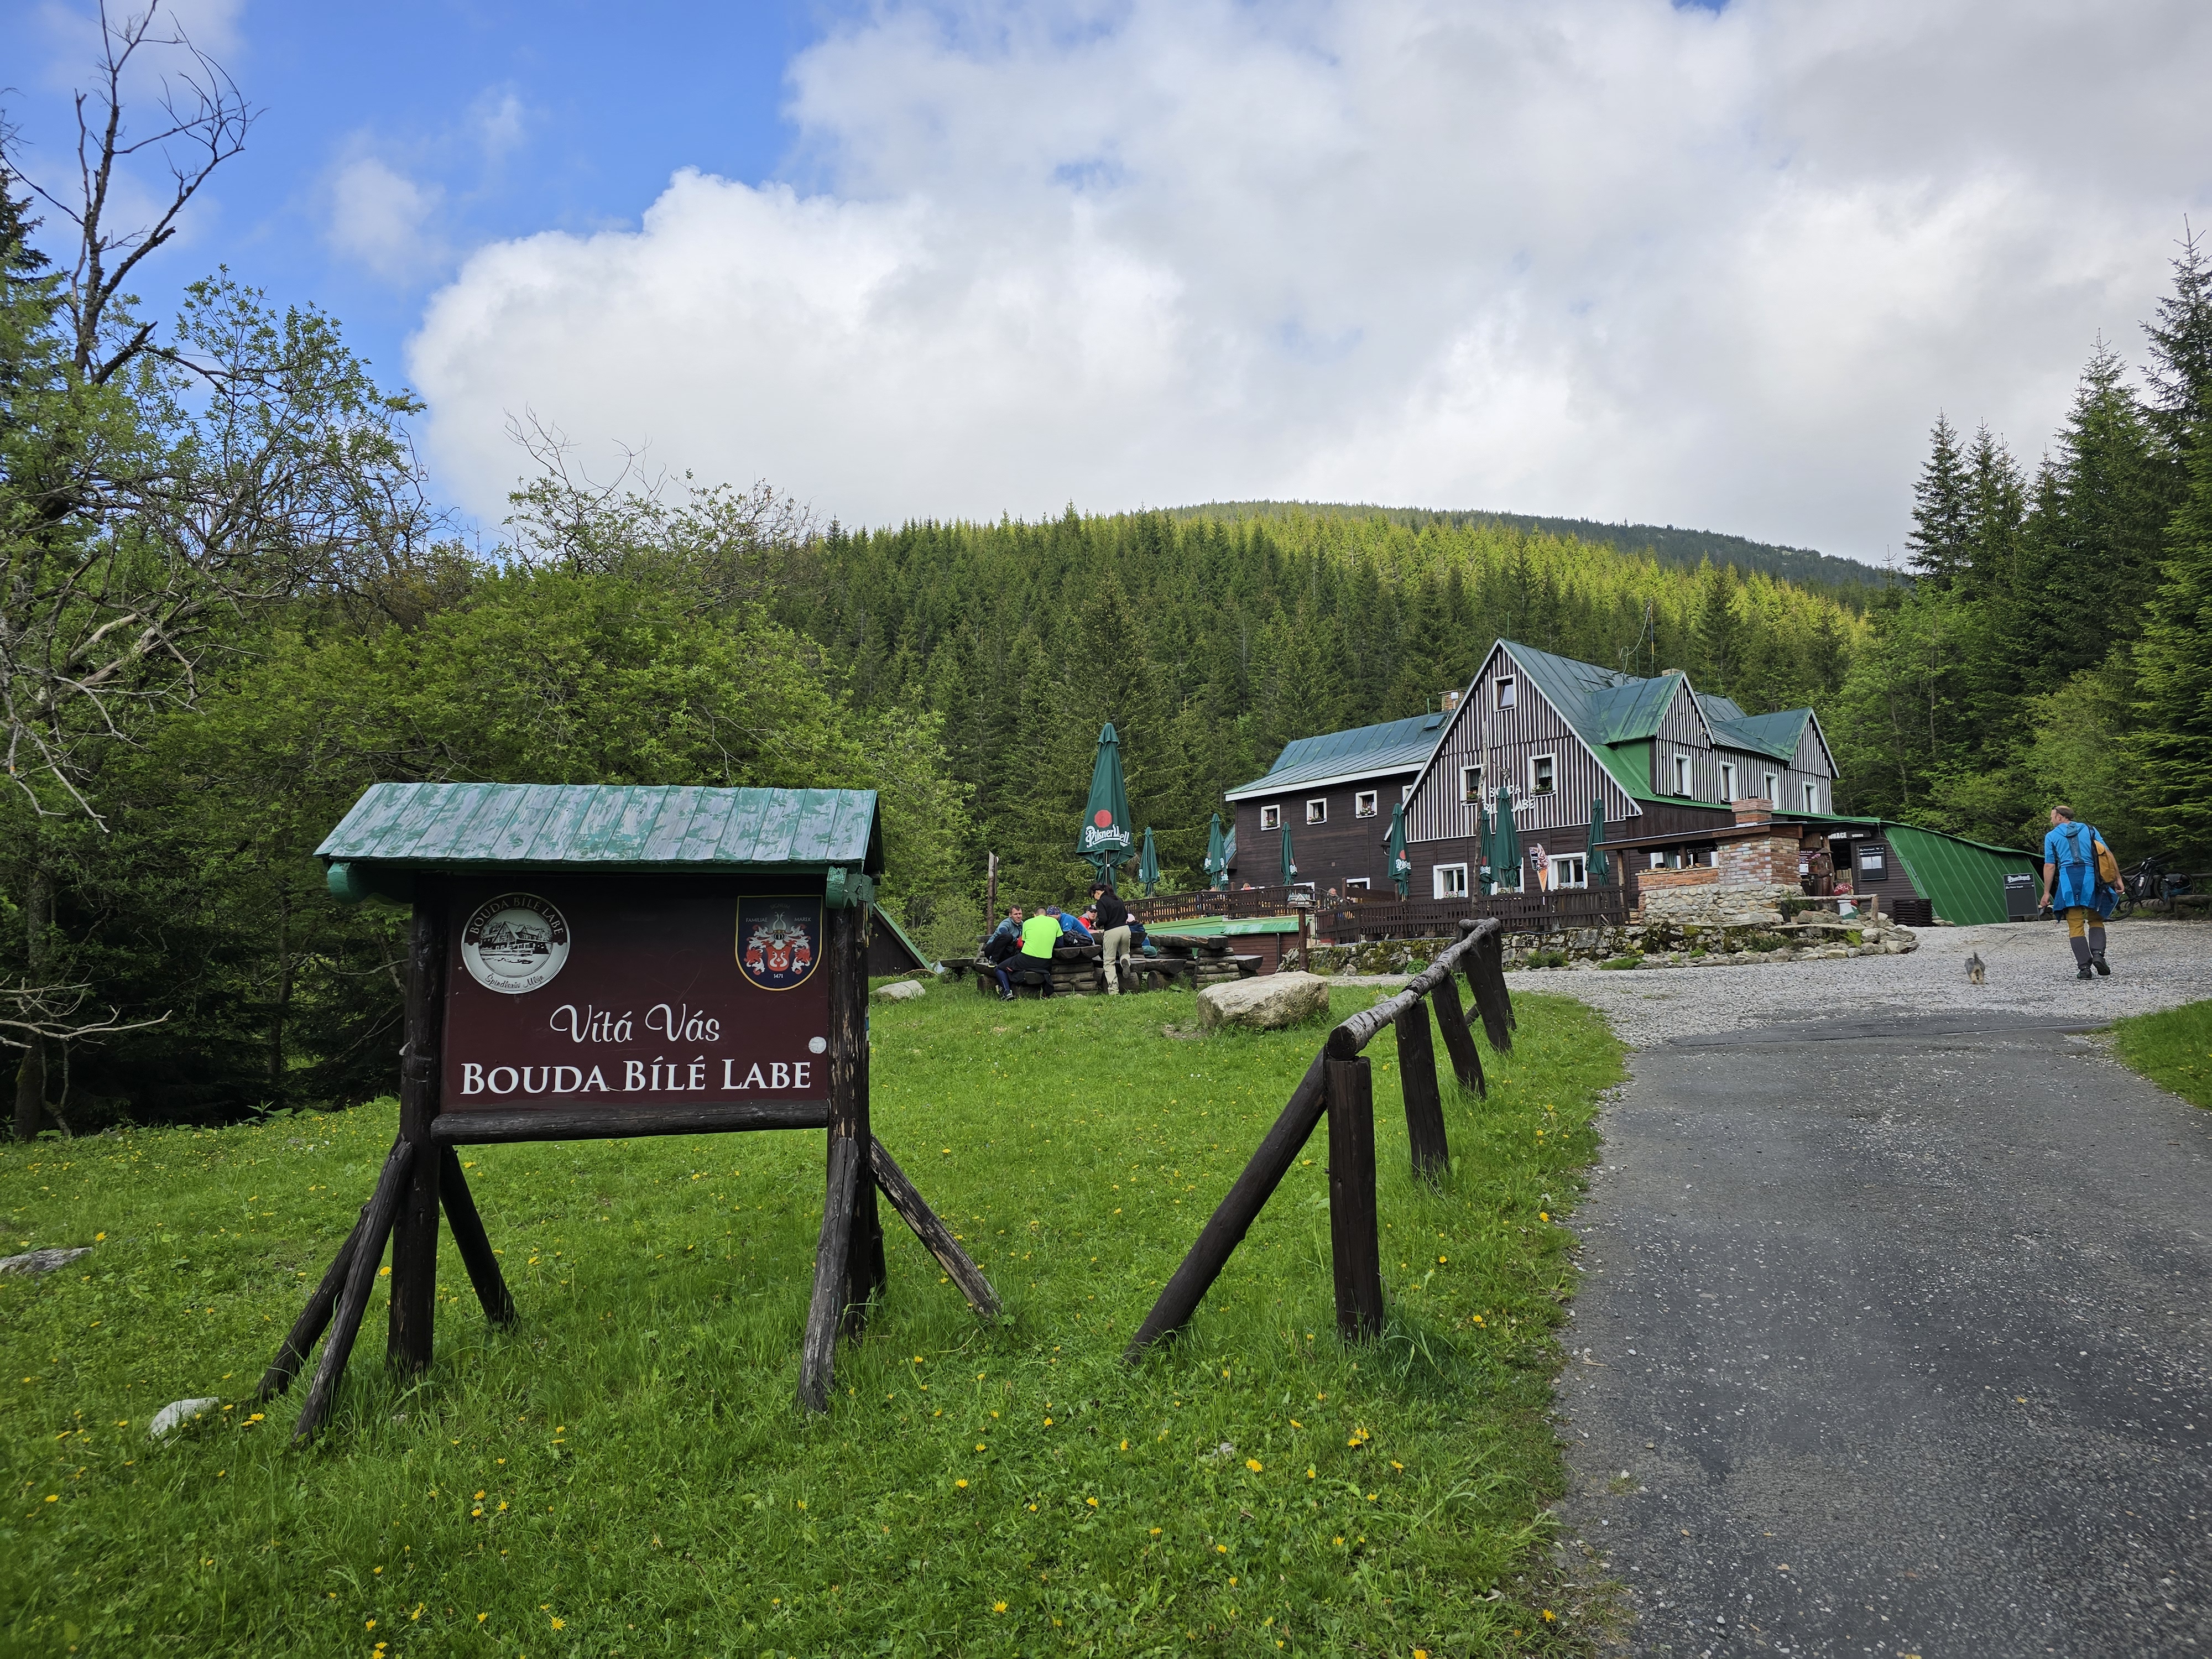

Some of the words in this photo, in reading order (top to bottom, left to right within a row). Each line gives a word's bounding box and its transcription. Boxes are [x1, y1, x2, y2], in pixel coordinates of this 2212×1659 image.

[1511, 798, 1536, 812] ABE
[1086, 825, 1114, 848] Pilsner
[1113, 824, 1129, 845] Uell
[469, 900, 509, 935] BOUDA
[513, 895, 542, 911] BÍLÉ
[542, 907, 564, 935] LABE
[485, 973, 521, 989] Špindlerův
[523, 975, 545, 988] Mlýn
[550, 1004, 633, 1043] Vítá
[645, 1003, 719, 1042] Vás
[460, 1063, 611, 1094] BOUDA
[623, 1055, 706, 1092] BÍLÉ
[721, 1058, 811, 1090] LABE
